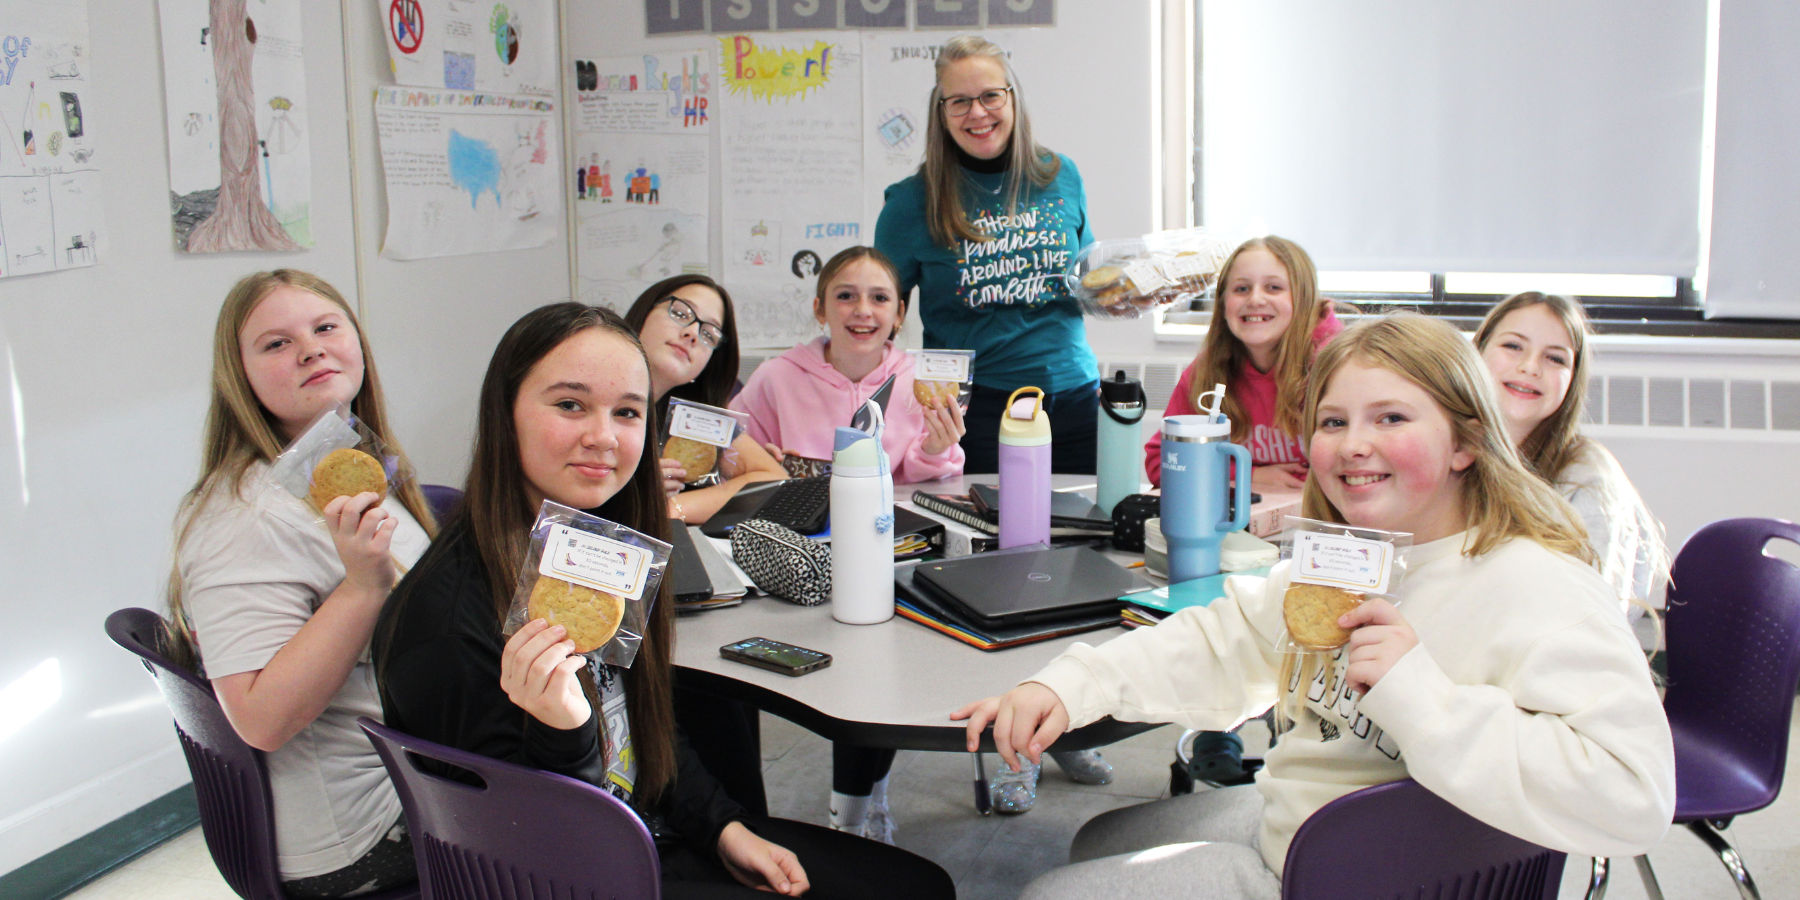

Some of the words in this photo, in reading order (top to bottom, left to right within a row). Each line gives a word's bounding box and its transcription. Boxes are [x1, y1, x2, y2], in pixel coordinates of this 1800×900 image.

[3, 36, 31, 57] Of
[734, 35, 830, 79] Power!
[576, 60, 638, 91] Human
[643, 55, 711, 115] Rights
[683, 95, 708, 128] HR
[805, 223, 860, 239] FIGHT!
[974, 210, 1037, 235] THROW
[961, 255, 1027, 286] AROUND
[1033, 250, 1070, 270] LIKE
[969, 271, 1063, 307] confetti
[1162, 462, 1187, 472] STANLEY
